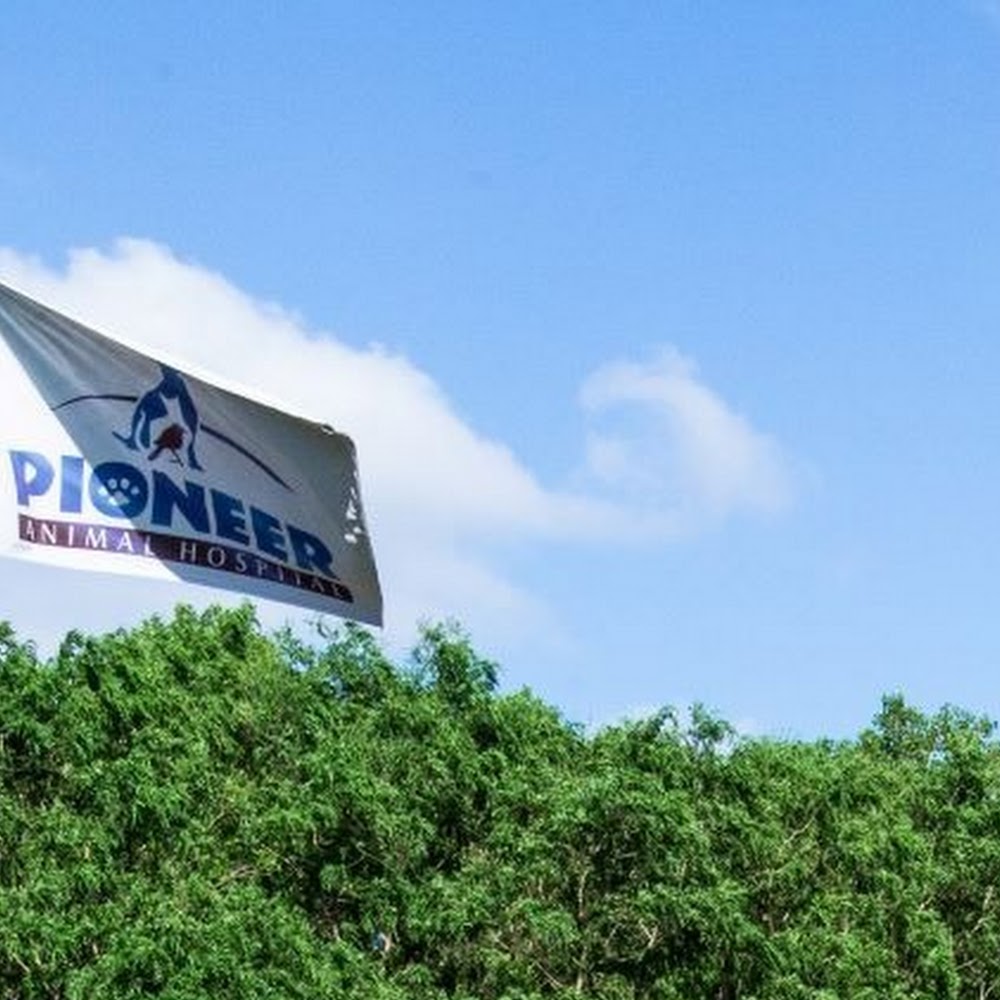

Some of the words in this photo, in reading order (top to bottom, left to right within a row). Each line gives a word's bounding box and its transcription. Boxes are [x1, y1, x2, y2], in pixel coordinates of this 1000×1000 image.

[11, 451, 340, 580] PIONEER
[26, 520, 155, 556] ANIMAL
[179, 541, 343, 597] HOSPITAL
